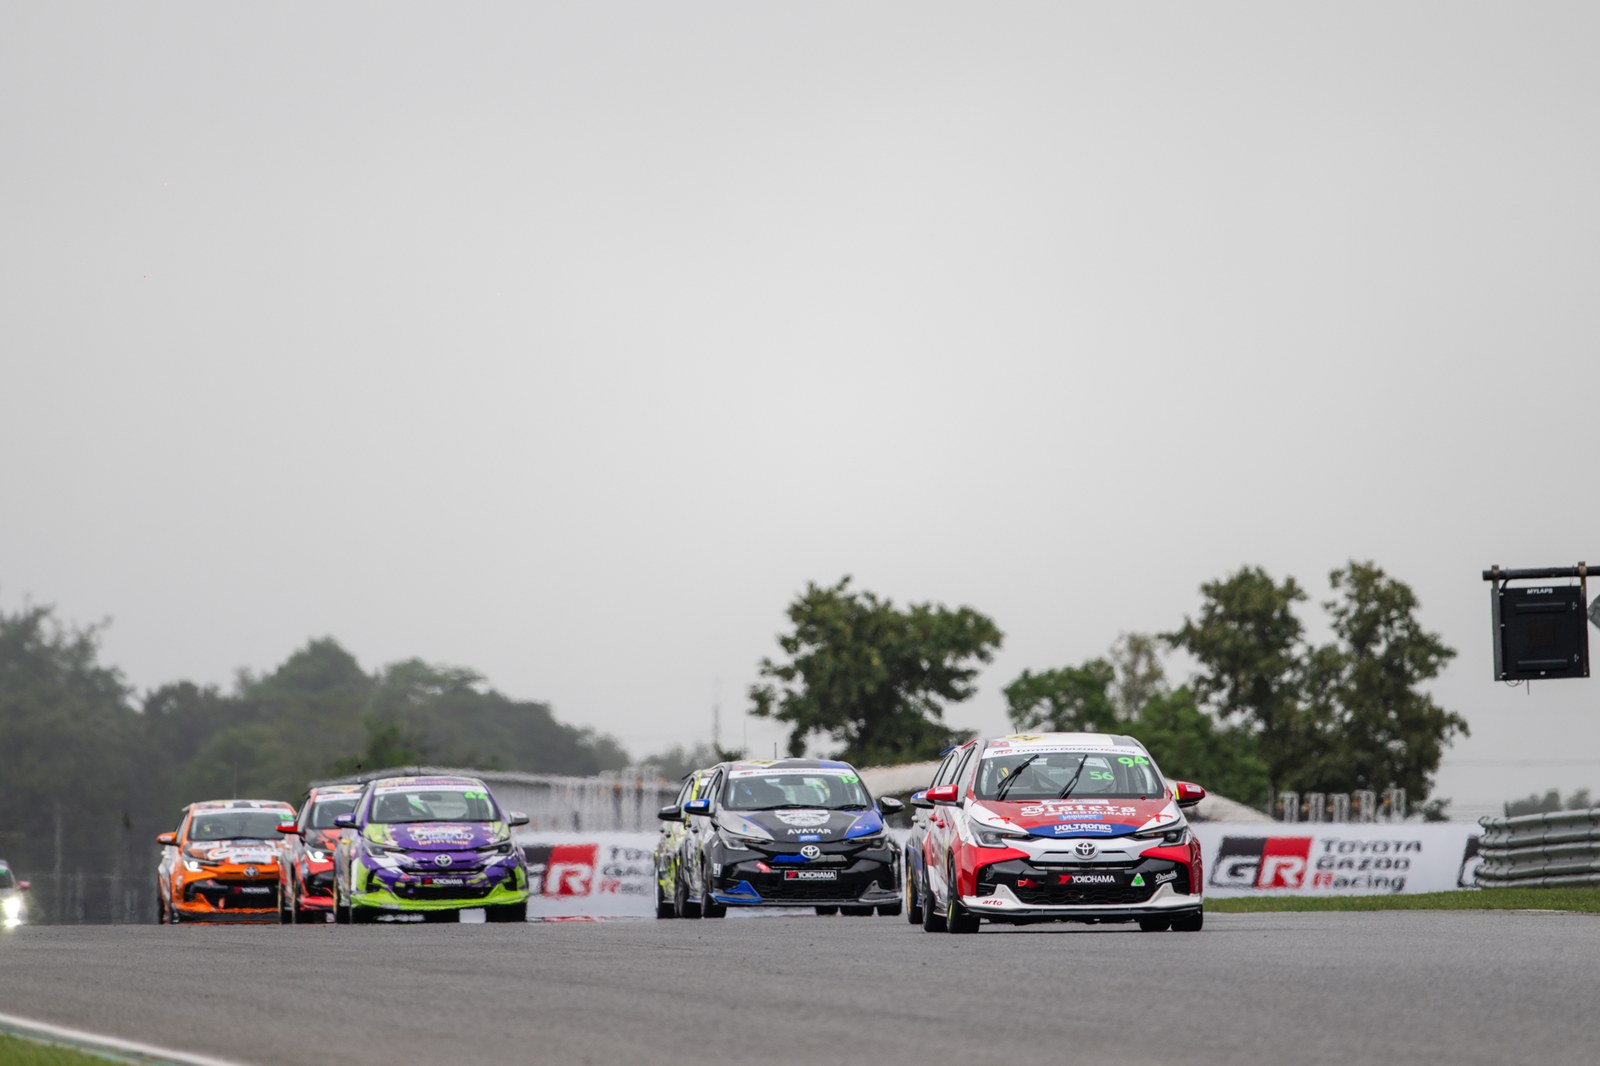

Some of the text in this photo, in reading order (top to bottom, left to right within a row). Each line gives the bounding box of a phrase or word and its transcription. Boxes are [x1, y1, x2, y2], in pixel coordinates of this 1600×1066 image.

[1118, 756, 1149, 768] 94
[1089, 771, 1114, 781] 56
[1054, 823, 1111, 832] VOLTRONIC
[1321, 838, 1422, 853] TOYOTA
[1209, 853, 1306, 887] GR
[798, 872, 835, 880] YOKOHAMA
[1072, 875, 1115, 883] YOKOHAMA
[1311, 872, 1405, 892] Racing
